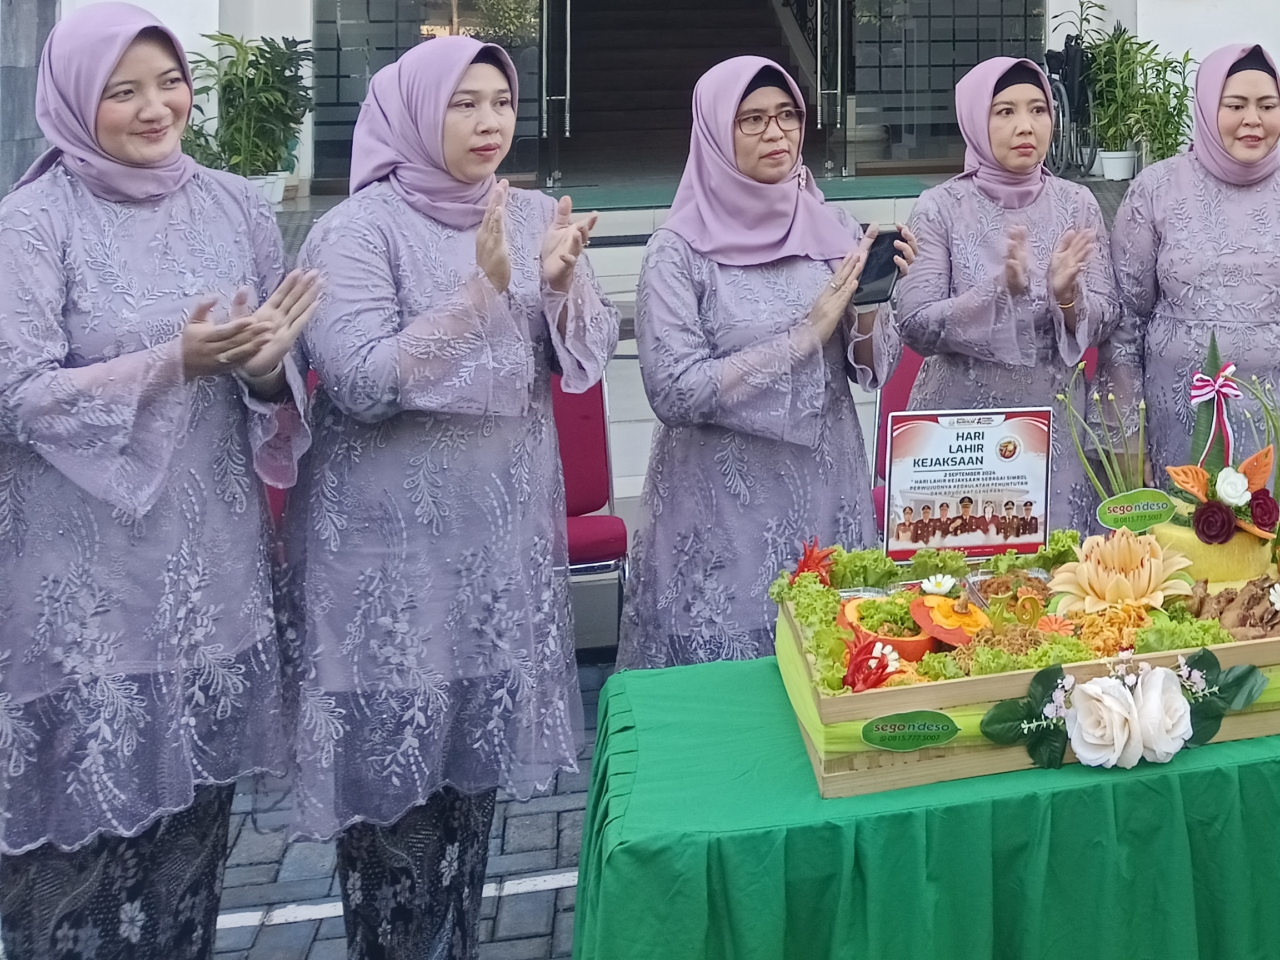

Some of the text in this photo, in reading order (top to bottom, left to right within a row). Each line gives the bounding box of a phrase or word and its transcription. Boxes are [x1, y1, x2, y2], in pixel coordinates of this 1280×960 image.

[956, 431, 985, 442] HARI
[949, 443, 984, 454] LAHIR
[913, 456, 984, 468] KEJAKSAAN
[1107, 504, 1133, 515] sego
[874, 723, 906, 733] sego
